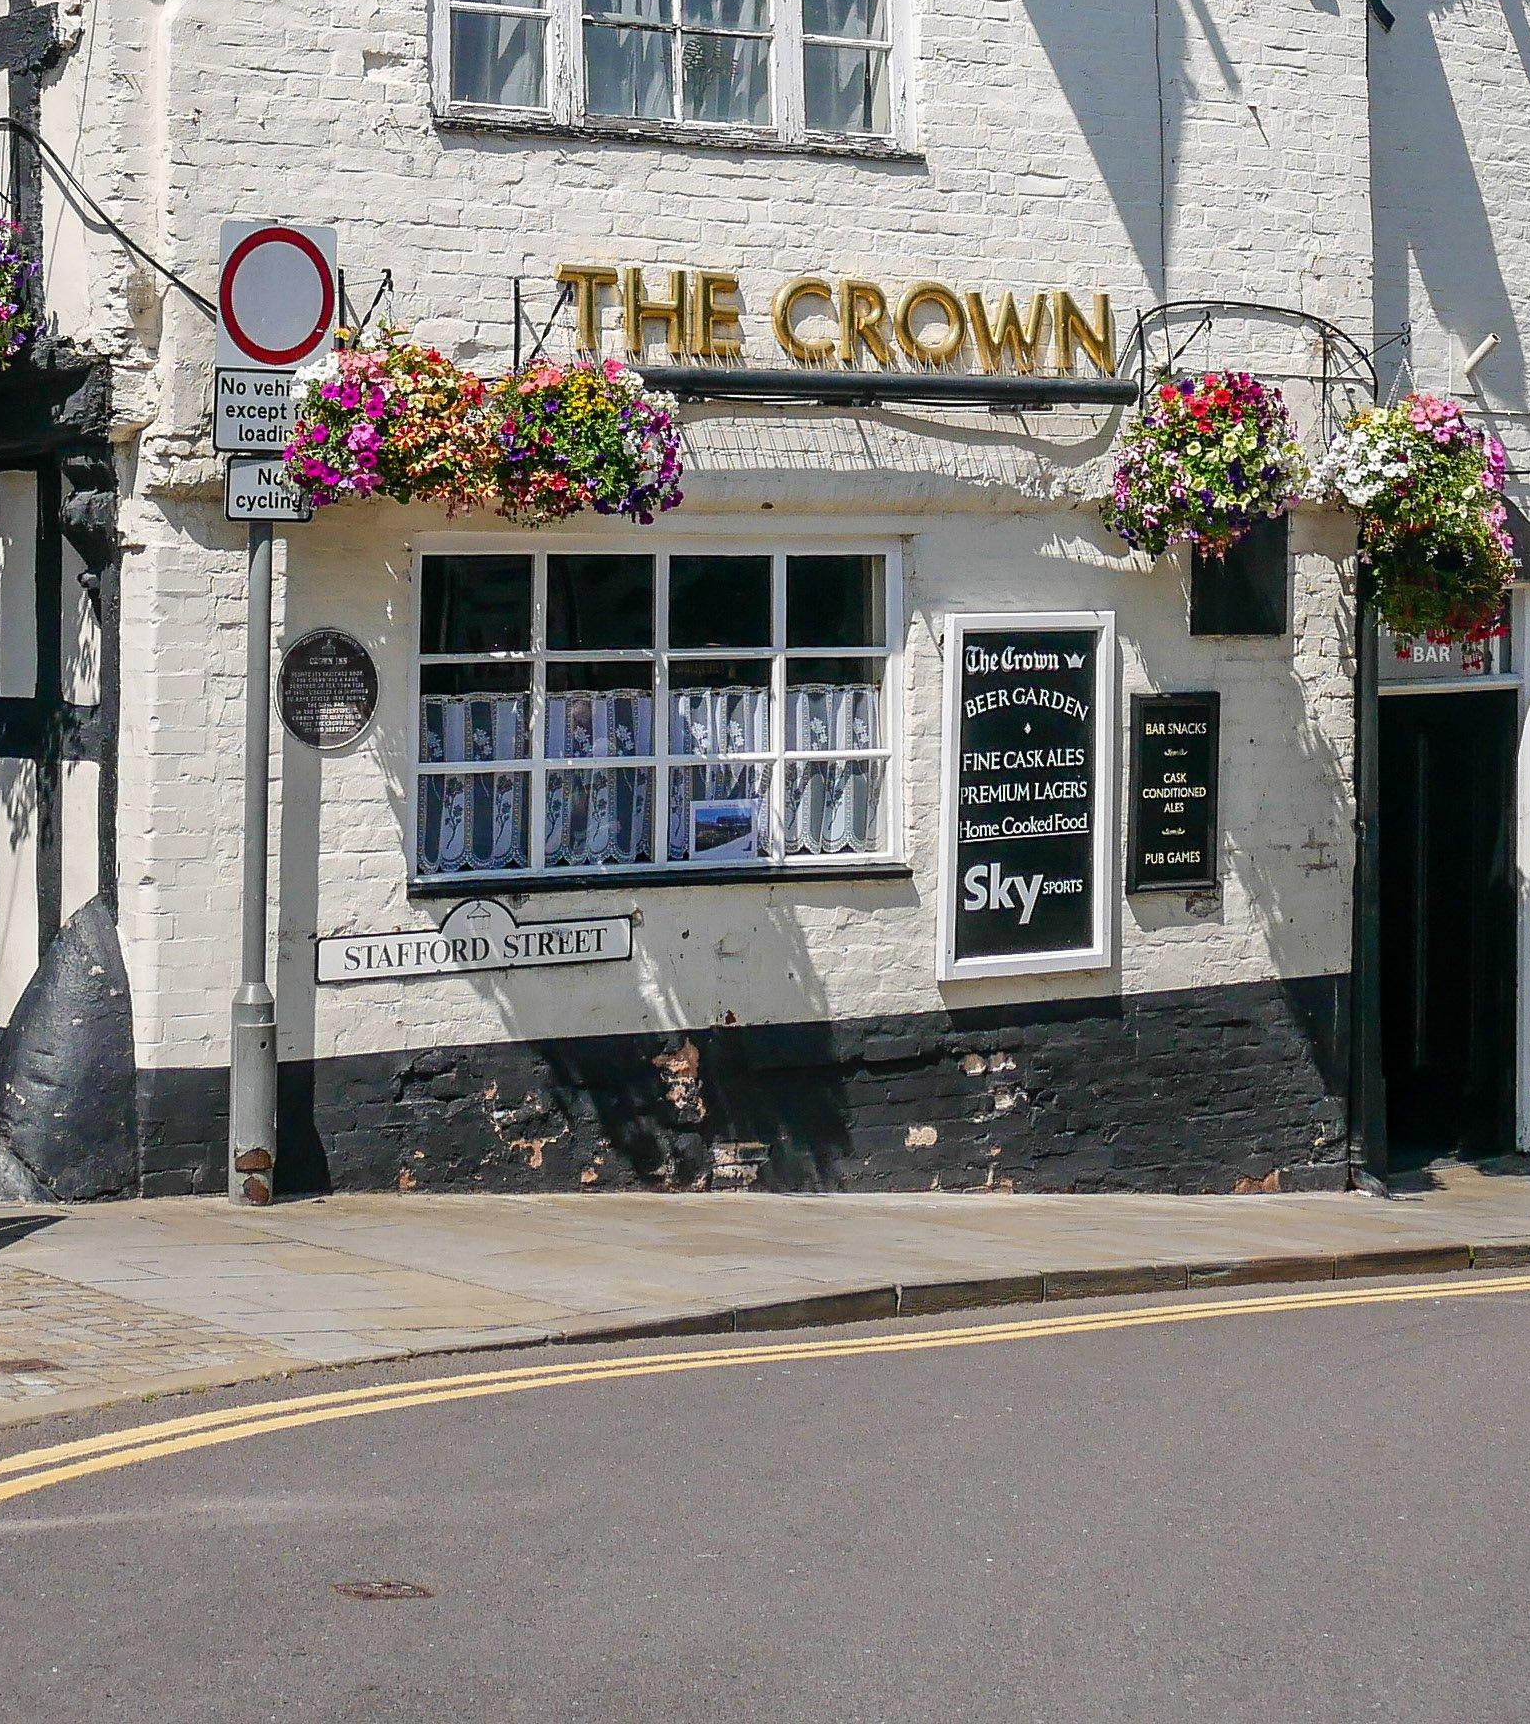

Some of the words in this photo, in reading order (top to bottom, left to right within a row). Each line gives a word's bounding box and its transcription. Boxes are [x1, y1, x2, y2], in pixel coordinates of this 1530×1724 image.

[554, 264, 741, 356] THE
[773, 276, 1116, 376] CROWN
[220, 377, 247, 396] No
[253, 379, 291, 397] vehi
[225, 403, 288, 423] except
[238, 424, 293, 443] loadin
[235, 491, 303, 513] cycling
[965, 645, 999, 676] The
[1000, 645, 1060, 673] Crown
[1412, 646, 1452, 663] BAR
[964, 689, 1011, 719] BEER
[1012, 687, 1089, 722] GARDEN
[1145, 723, 1166, 735] BAR
[1167, 722, 1207, 735] SNACKS
[962, 751, 1002, 772] FINE
[1003, 749, 1045, 769] CASK
[1046, 748, 1086, 768] ALES
[1163, 773, 1187, 784] CASK
[960, 783, 1031, 806] PREMIUM
[1033, 781, 1089, 801] LAGERS
[1142, 786, 1207, 799] CONDITIONED
[1163, 802, 1185, 813] ALES
[959, 820, 1000, 839] Home
[1001, 815, 1054, 836] Cooked
[1054, 812, 1088, 831] Food
[1144, 853, 1165, 865] PUB
[1166, 851, 1201, 864] GAMES
[963, 862, 1044, 926] Sky
[1042, 879, 1084, 895] SPORTS
[344, 937, 490, 971] STAFFORD
[503, 927, 608, 959] STREET
